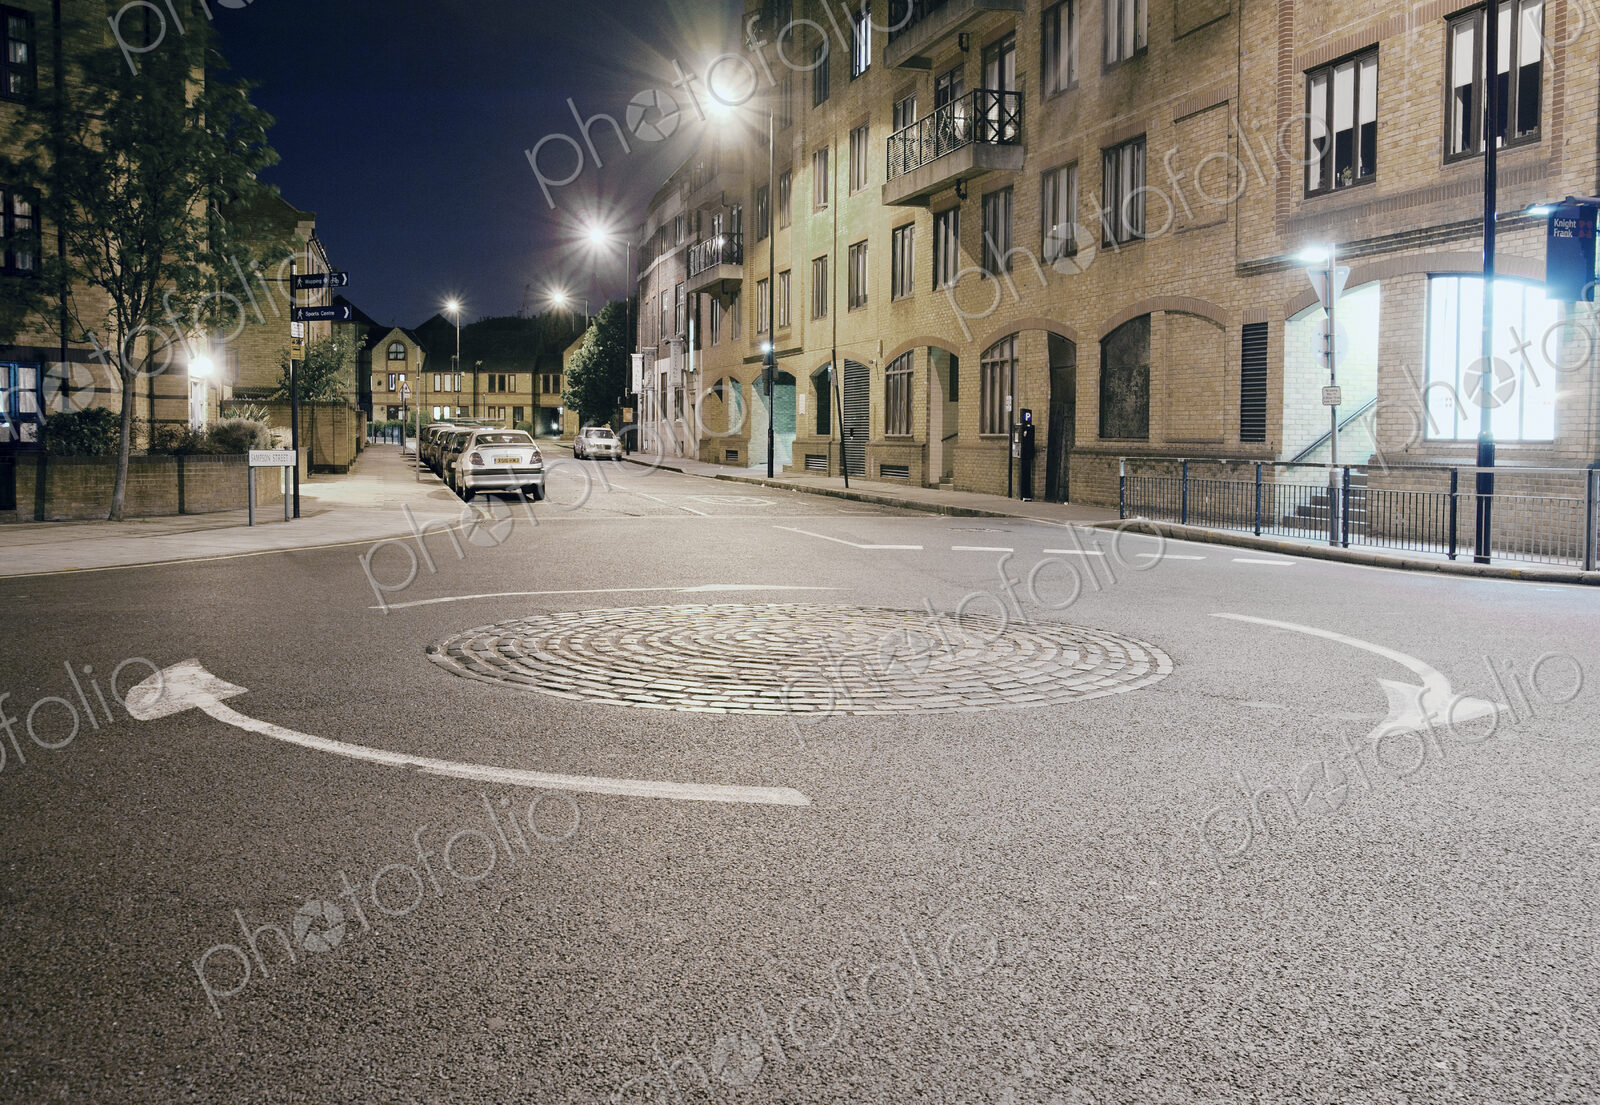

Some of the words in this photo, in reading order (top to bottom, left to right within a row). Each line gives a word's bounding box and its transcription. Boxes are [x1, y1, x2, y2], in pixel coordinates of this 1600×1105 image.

[1553, 219, 1576, 229] Knight
[1553, 229, 1573, 238] Frank
[251, 453, 270, 462] SAMPSON
[272, 453, 288, 462] STREET
